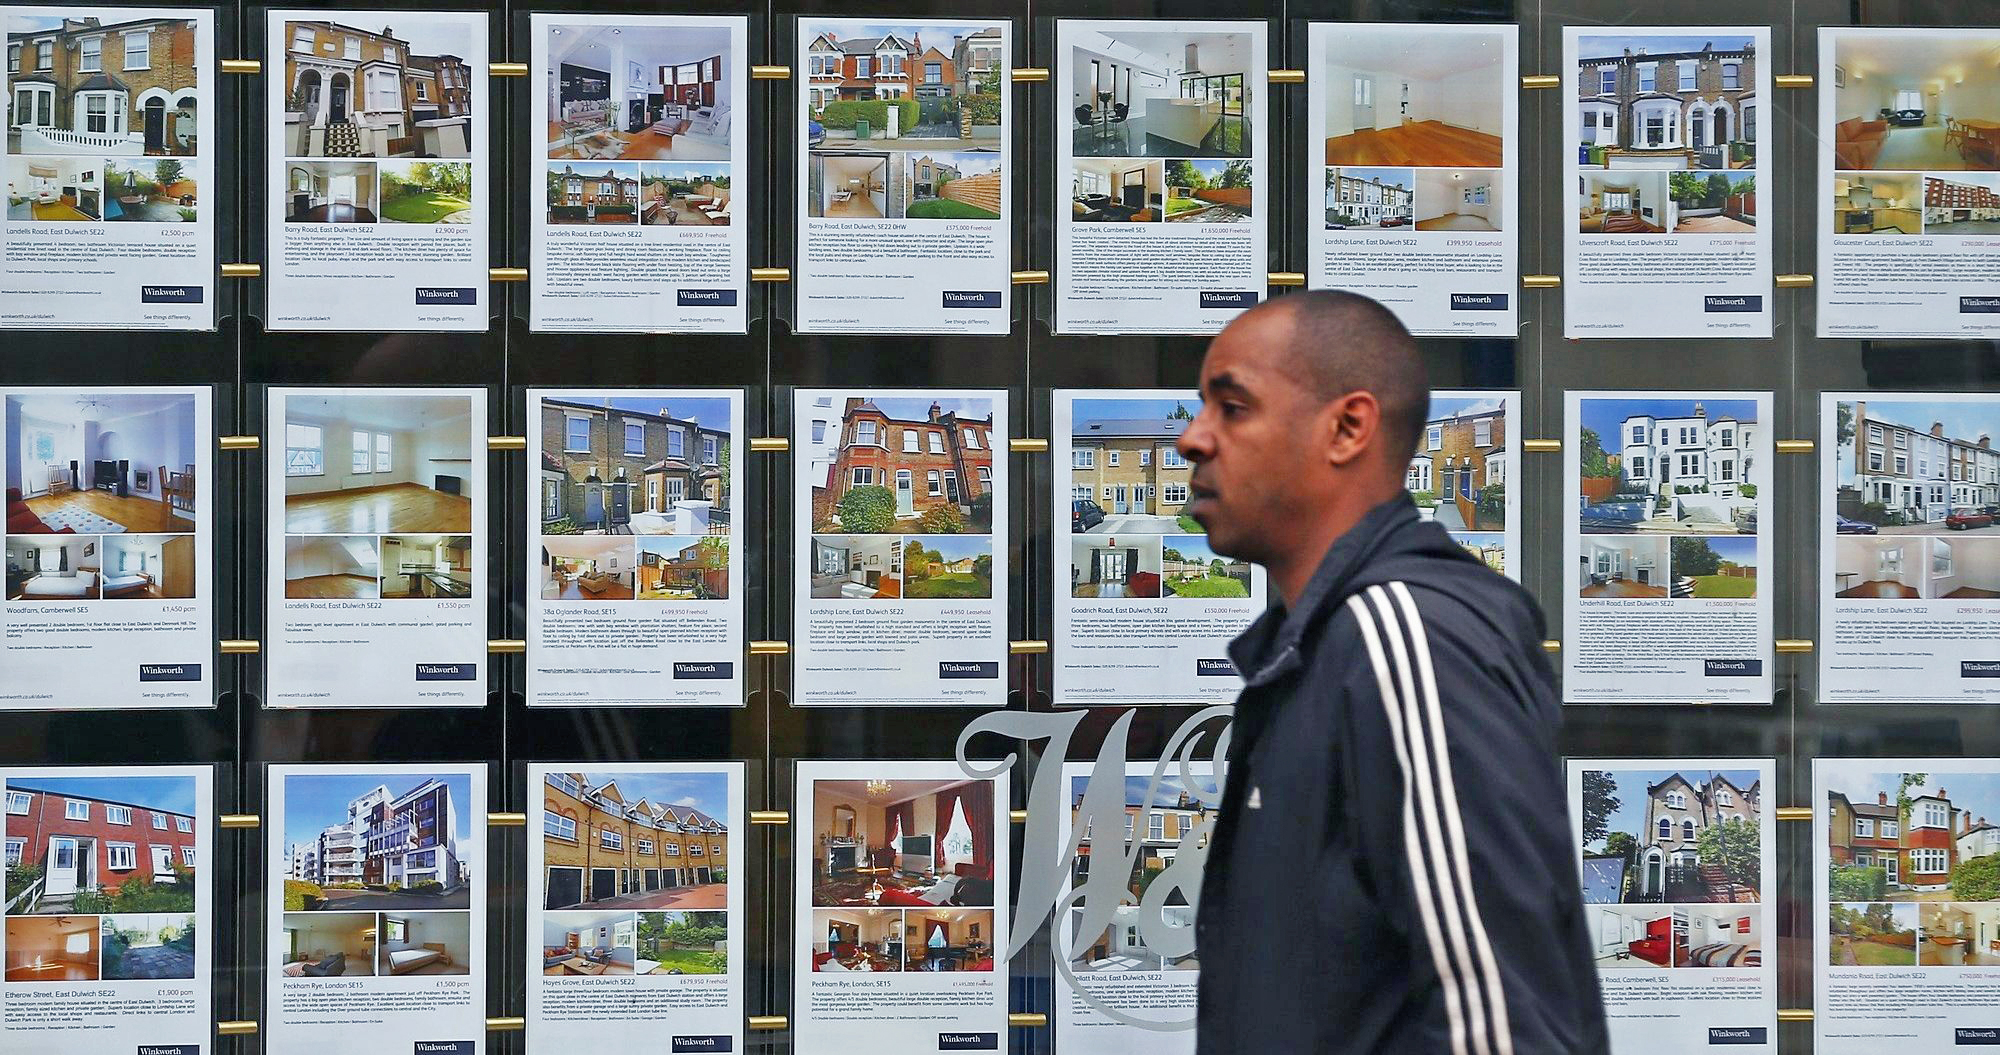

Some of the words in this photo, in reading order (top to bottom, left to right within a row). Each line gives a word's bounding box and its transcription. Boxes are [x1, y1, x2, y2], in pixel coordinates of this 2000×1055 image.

[144, 288, 185, 296] Winkworth
[679, 291, 719, 299] Winkworth
[945, 293, 984, 301] Winkworth
[1202, 293, 1241, 301] Winkworth
[1962, 298, 2000, 306] Winkworth
[676, 664, 715, 672] Winkworth
[1199, 660, 1234, 669] Winkwor
[142, 666, 183, 674] Winkworth
[5, 991, 32, 999] Etherow
[1957, 1030, 1996, 1038] Winkworth
[140, 1047, 181, 1055] Winkworth
[417, 1043, 457, 1051] Winkworth
